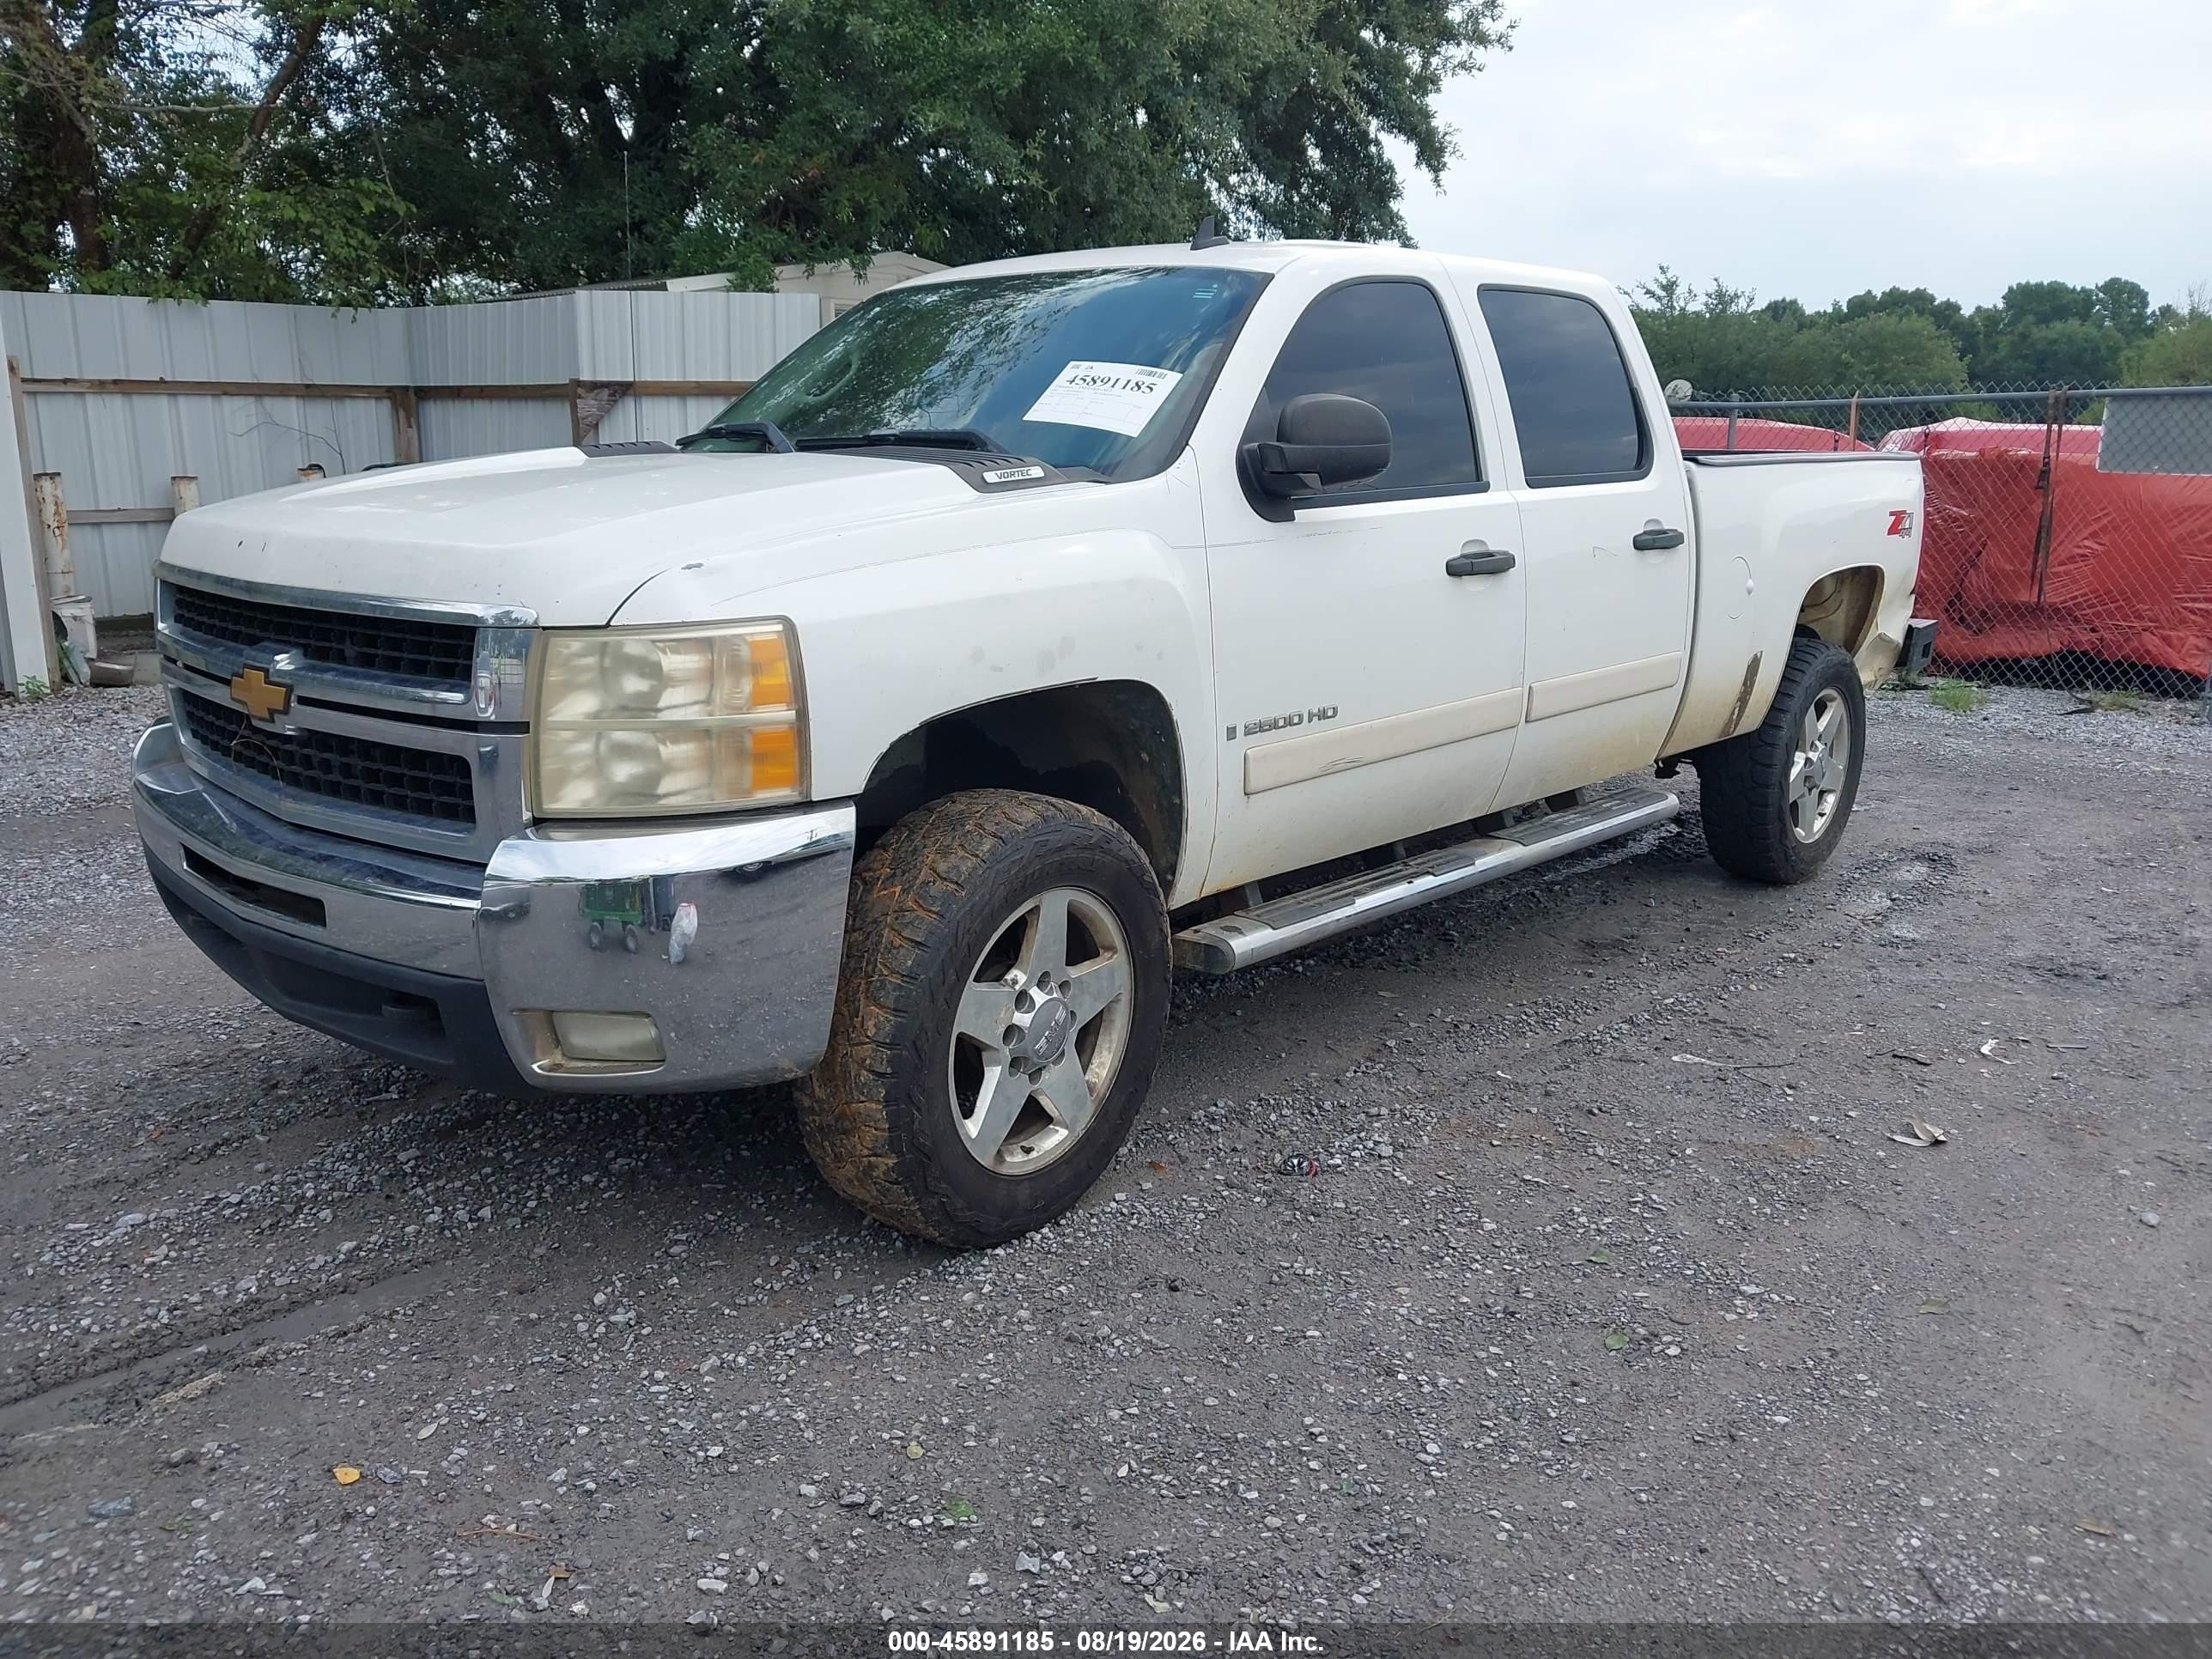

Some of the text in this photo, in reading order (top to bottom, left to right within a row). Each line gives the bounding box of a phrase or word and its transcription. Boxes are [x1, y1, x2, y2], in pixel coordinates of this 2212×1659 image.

[1066, 374, 1159, 395] 45891185
[995, 469, 1032, 480] VORTEC
[1243, 705, 1339, 736] 2500 HD
